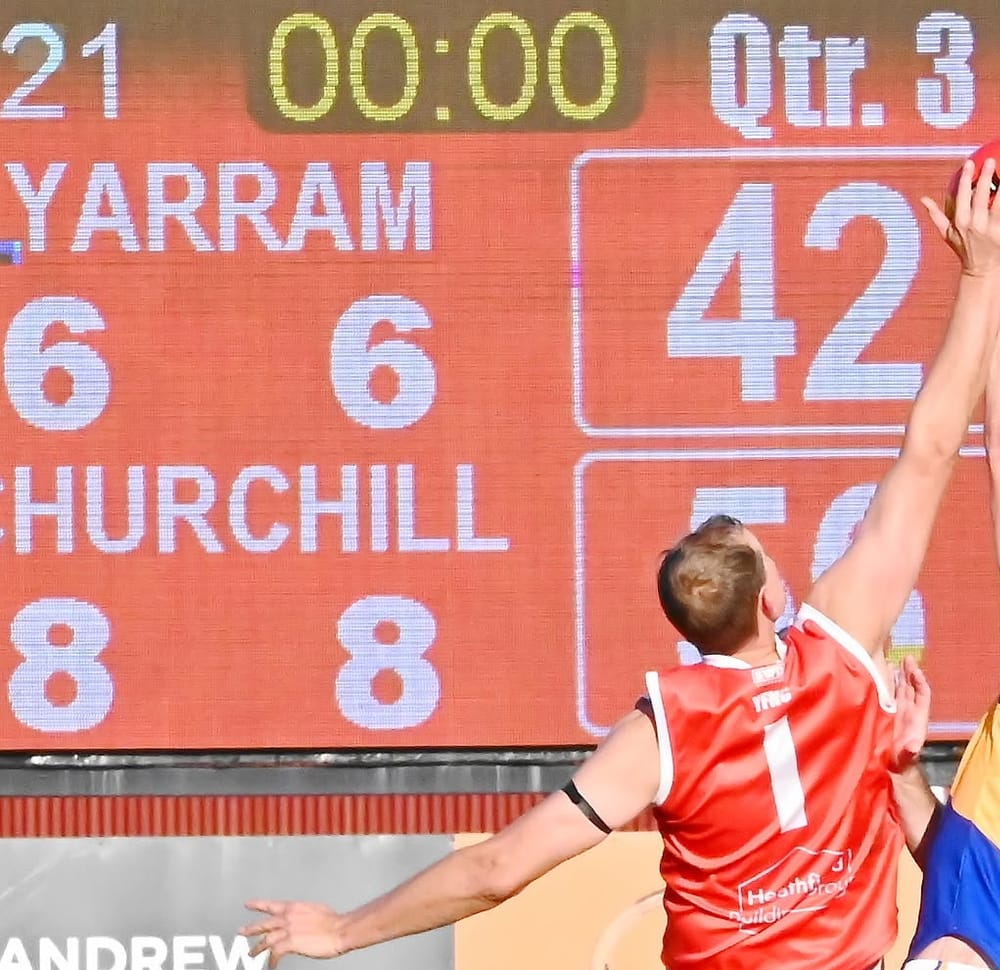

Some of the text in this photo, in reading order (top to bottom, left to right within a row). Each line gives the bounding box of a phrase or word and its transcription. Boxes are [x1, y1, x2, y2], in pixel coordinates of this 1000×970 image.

[0, 12, 976, 139] 21 00:00 Qtr. 3
[4, 161, 432, 252] YARRAM
[667, 182, 924, 403] 42
[3, 293, 438, 431] 6 6
[0, 464, 510, 553] HURCHILL
[8, 595, 441, 732] 8 8
[764, 715, 808, 834] 1
